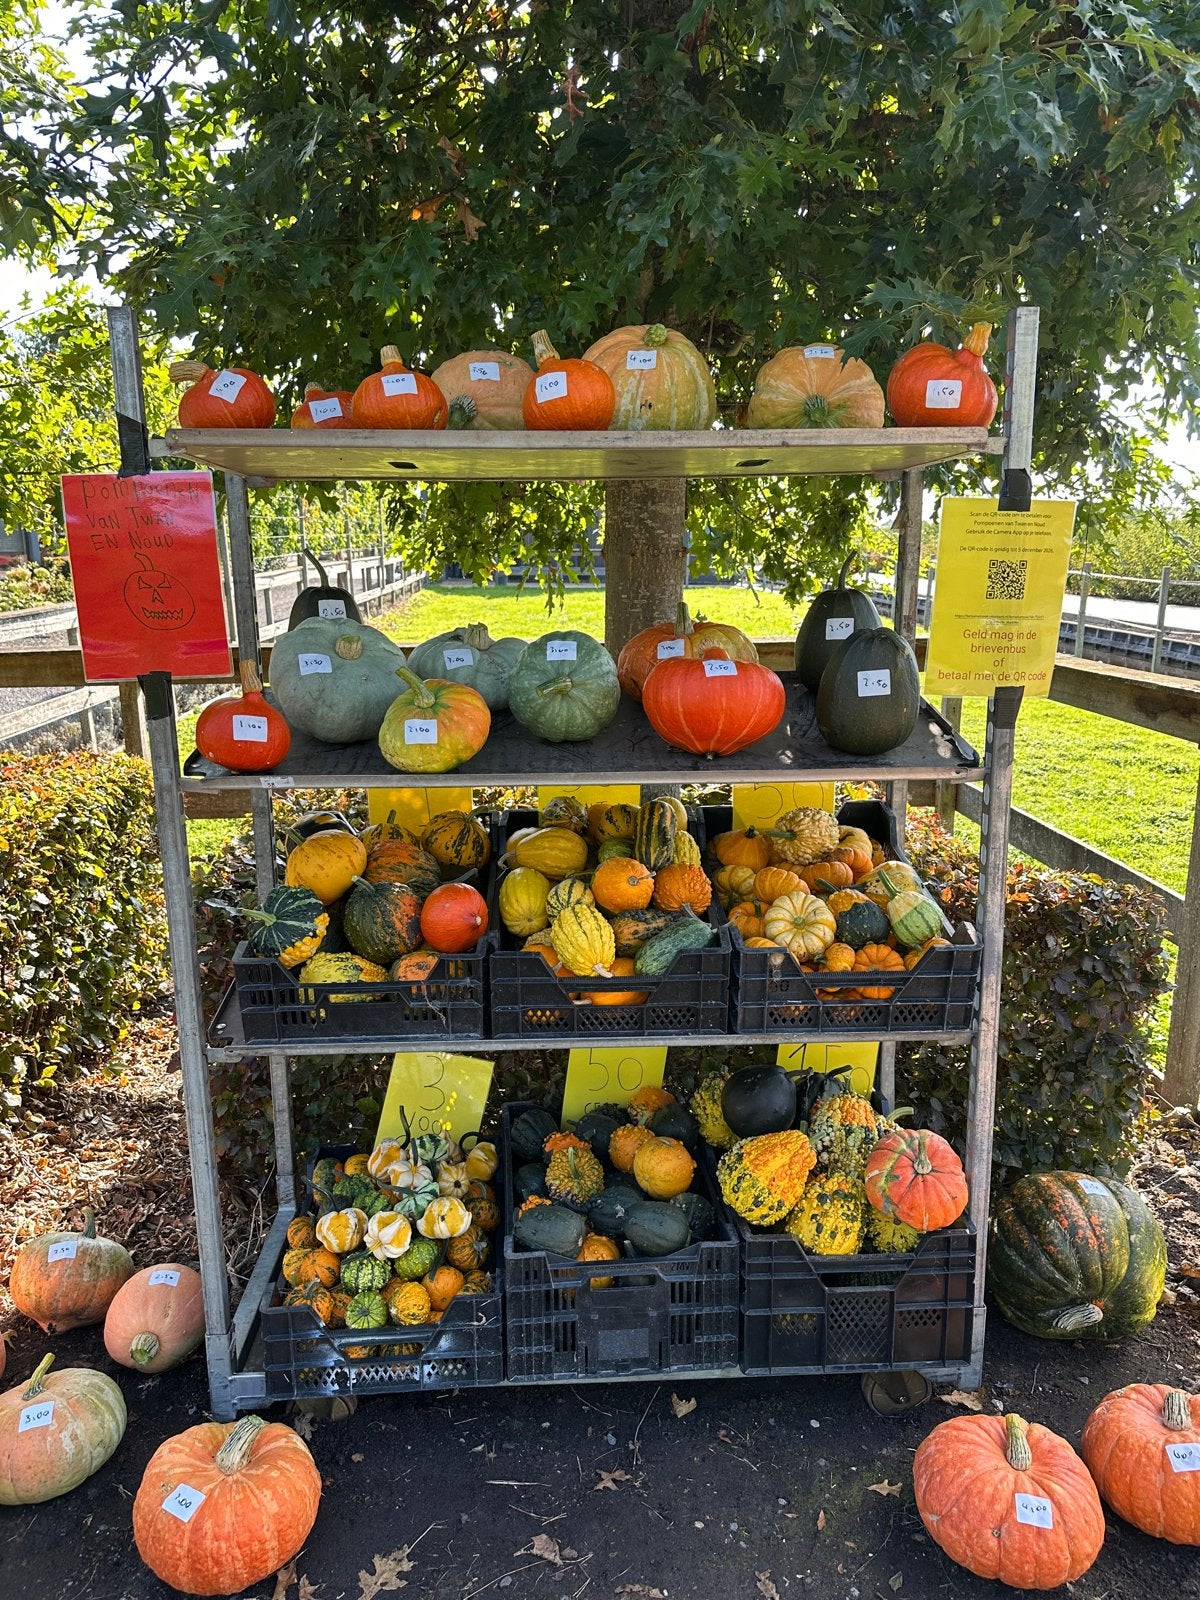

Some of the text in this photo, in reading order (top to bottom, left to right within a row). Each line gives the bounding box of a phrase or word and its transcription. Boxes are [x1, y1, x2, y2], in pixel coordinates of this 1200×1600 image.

[90, 533, 119, 551] EN
[963, 628, 1037, 642] Geld mag in de
[971, 643, 1026, 654] brievenbus
[993, 657, 1005, 667] of
[938, 670, 971, 680] betaal
[998, 671, 1011, 681] de
[1013, 671, 1027, 681] QR
[1028, 670, 1047, 681] code
[588, 1048, 644, 1091] 50
[420, 1055, 446, 1111] 3
